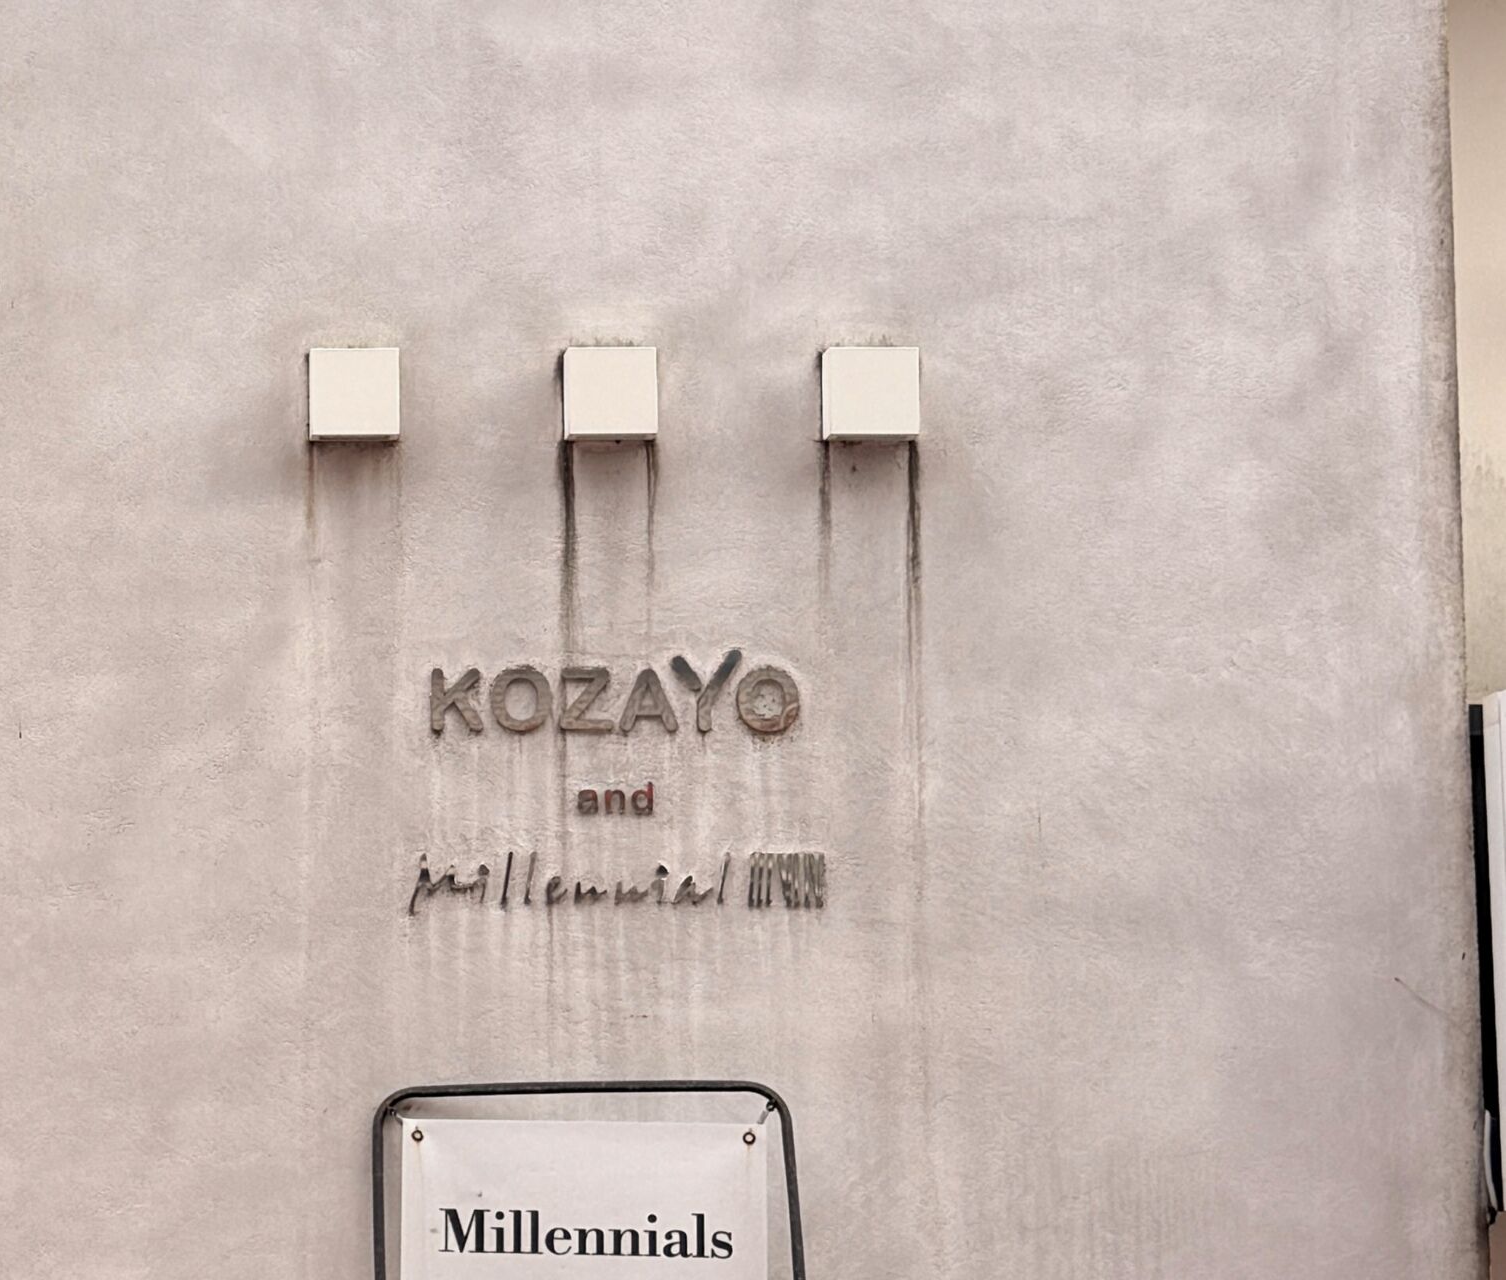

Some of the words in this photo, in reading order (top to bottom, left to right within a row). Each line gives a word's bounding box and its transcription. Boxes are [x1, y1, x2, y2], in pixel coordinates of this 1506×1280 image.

[429, 649, 800, 734] KOZAYO
[577, 781, 654, 816] and
[439, 1208, 733, 1259] Millennials
